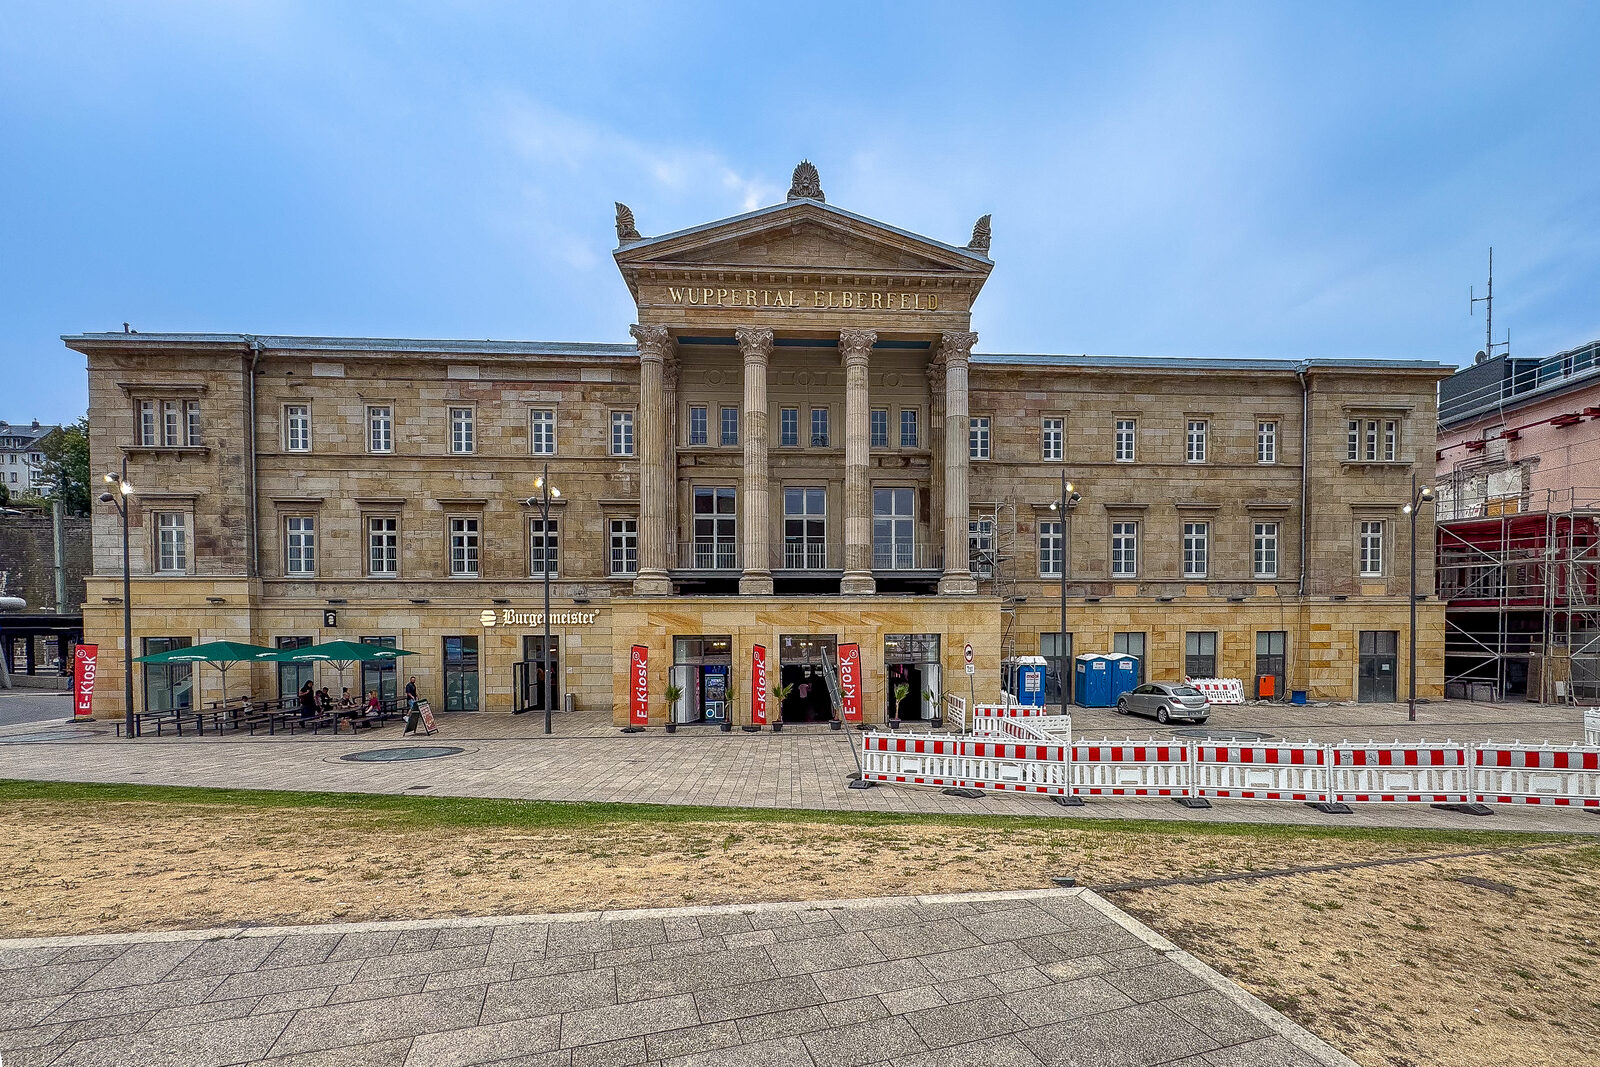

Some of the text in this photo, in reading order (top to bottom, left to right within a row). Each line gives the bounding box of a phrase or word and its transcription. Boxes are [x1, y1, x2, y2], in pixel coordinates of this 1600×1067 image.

[668, 287, 938, 311] WUPPERTAL ELBERFELD
[79, 656, 97, 709] E-Kiosk
[636, 659, 648, 718] E-Kiosk
[756, 659, 766, 719] E-Kiosk
